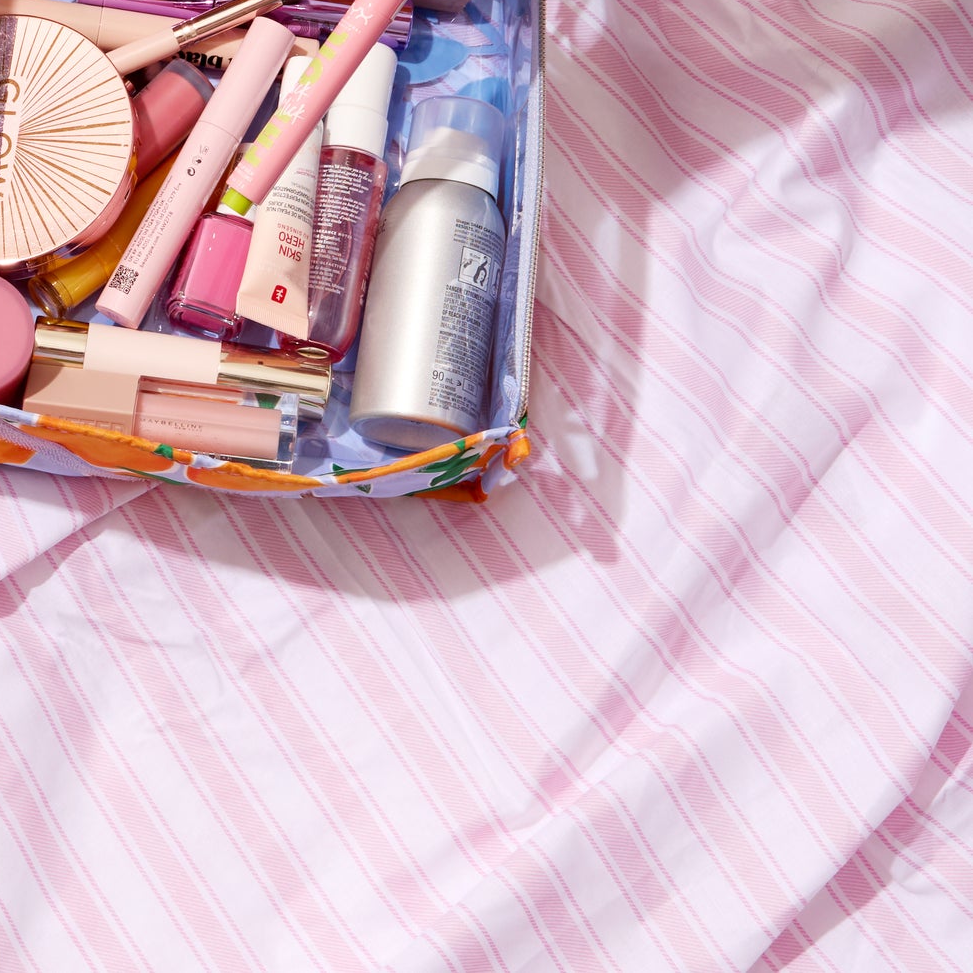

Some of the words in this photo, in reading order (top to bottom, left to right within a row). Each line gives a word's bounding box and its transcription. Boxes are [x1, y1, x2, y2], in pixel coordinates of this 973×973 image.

[278, 231, 305, 249] HERO
[278, 244, 303, 262] SKIN
[432, 370, 445, 382] 90
